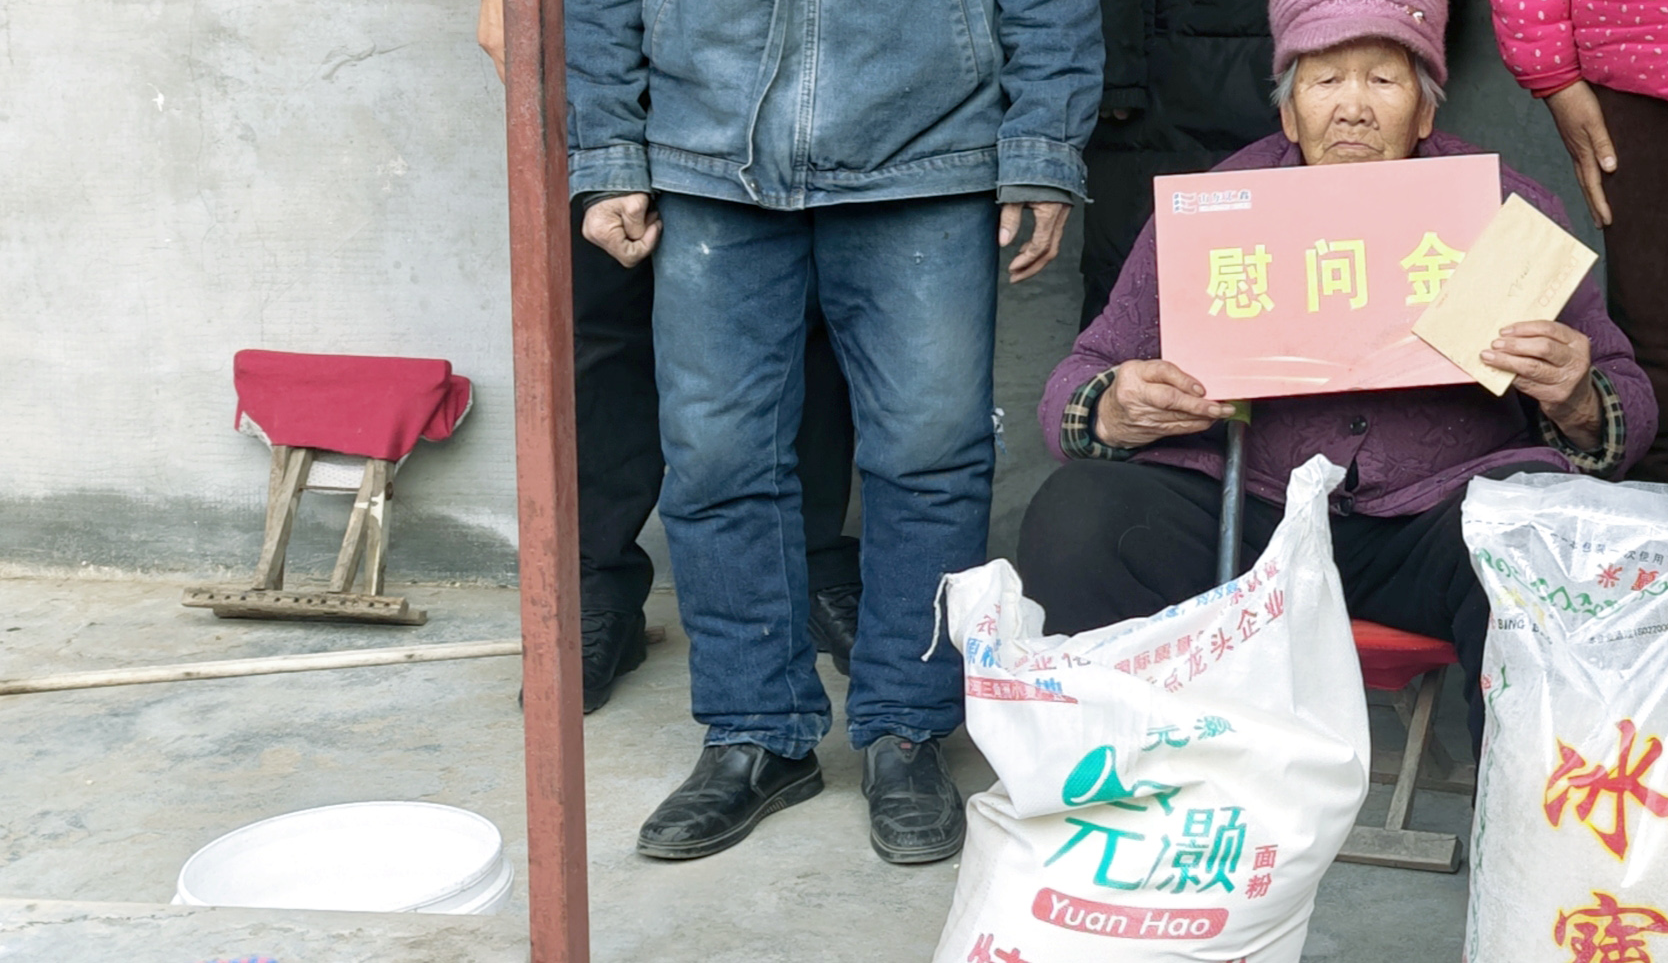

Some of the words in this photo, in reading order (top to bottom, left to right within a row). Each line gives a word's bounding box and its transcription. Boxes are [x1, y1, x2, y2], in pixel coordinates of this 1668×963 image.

[1206, 231, 1466, 319] 慰问金
[1245, 844, 1279, 899] 面粉
[1050, 894, 1128, 934] Yuan
[1139, 912, 1211, 937] Hao
